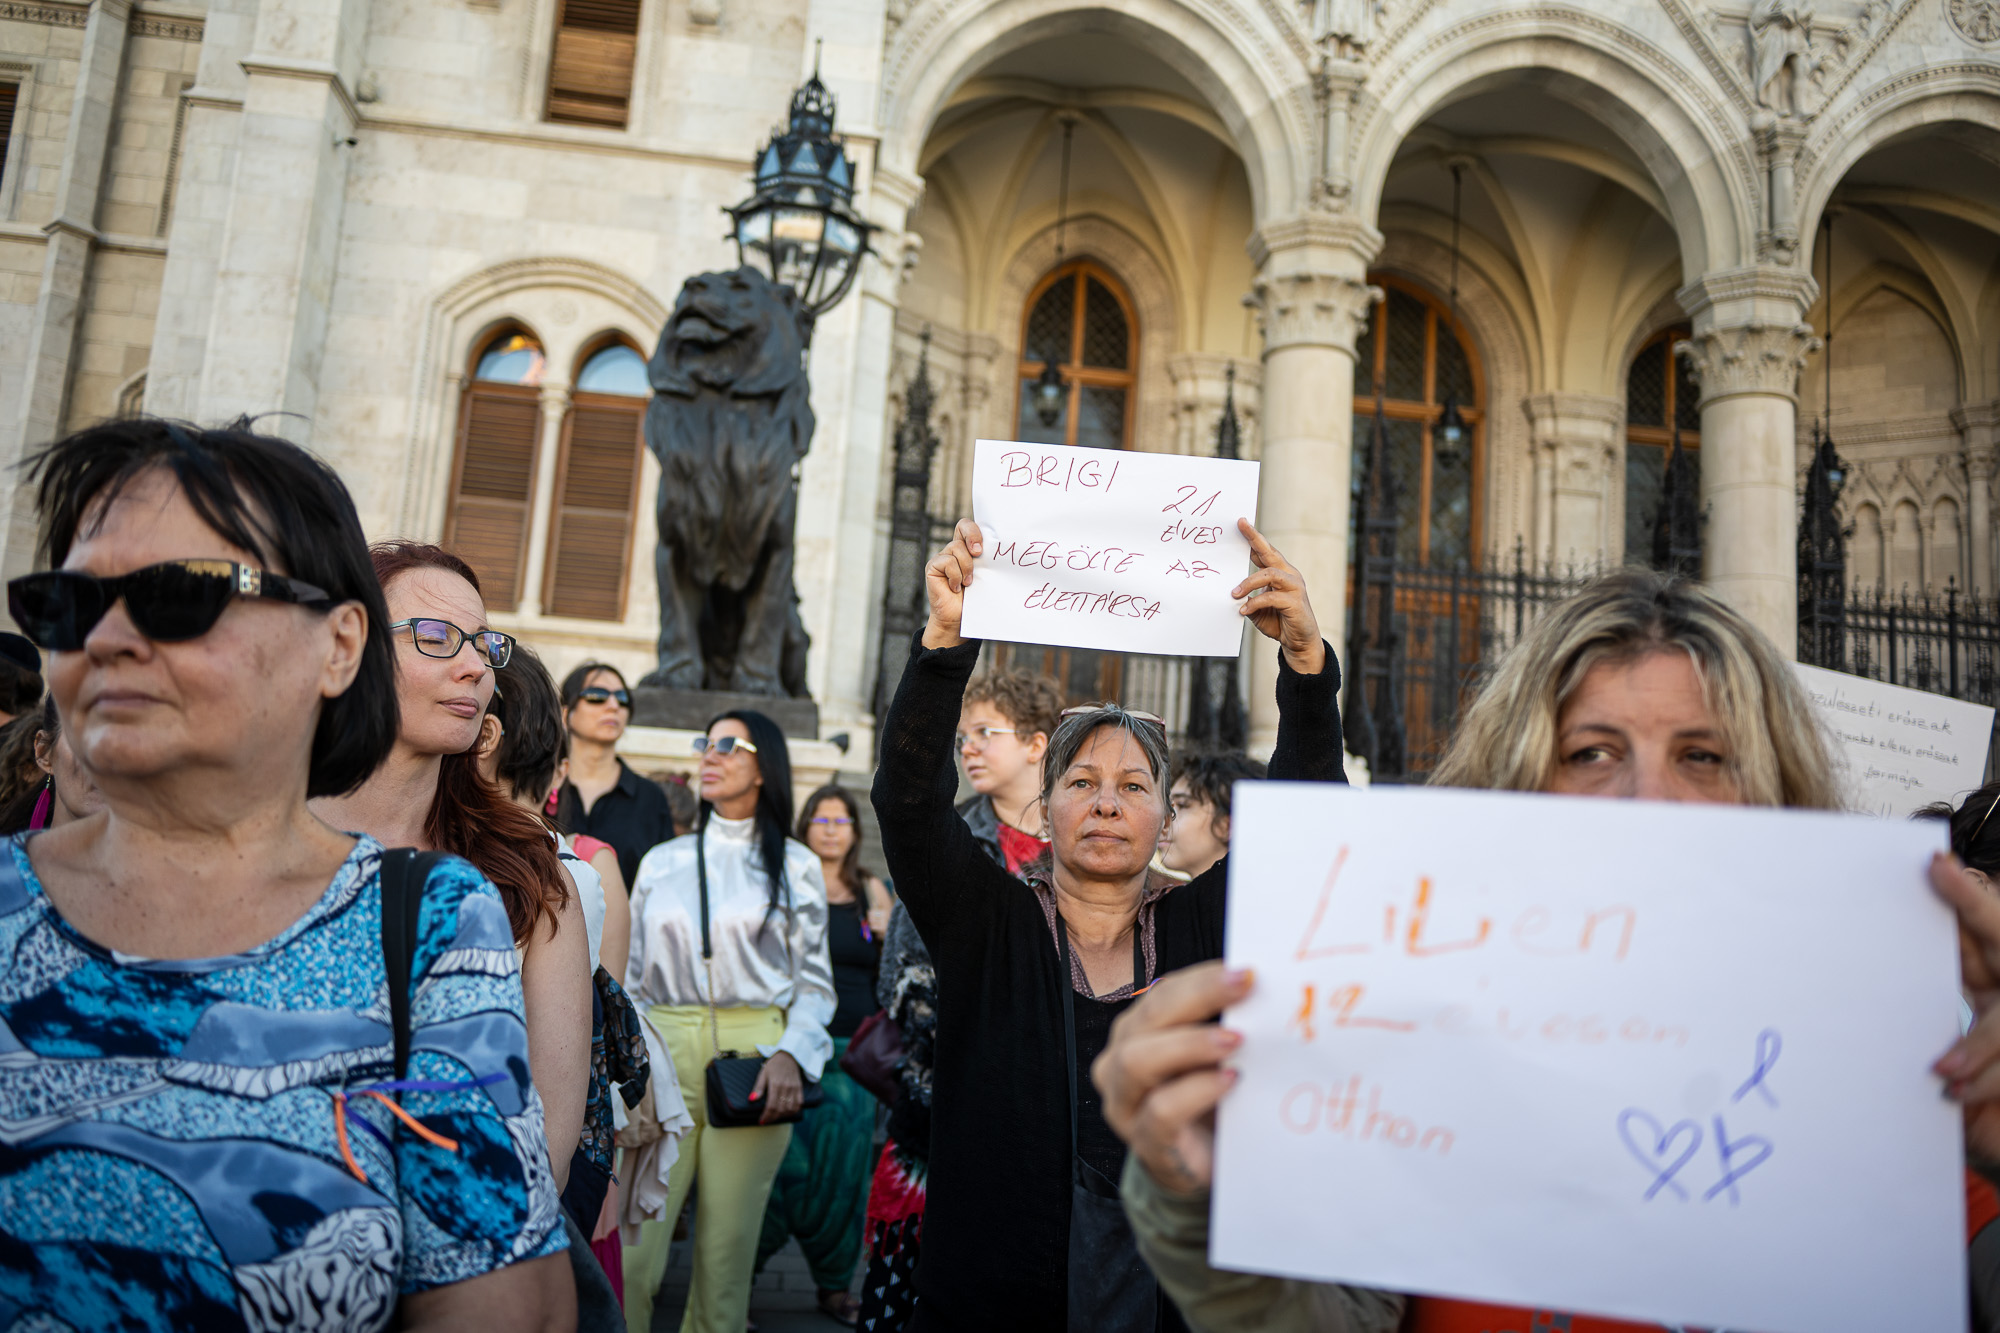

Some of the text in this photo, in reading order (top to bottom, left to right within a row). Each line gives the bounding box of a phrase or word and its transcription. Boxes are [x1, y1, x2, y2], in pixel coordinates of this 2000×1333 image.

[1000, 451, 1120, 492] BRIGI
[1162, 485, 1222, 516] 21
[1160, 519, 1223, 544] ÉVES
[993, 541, 1221, 578] MEGÖLTE AZ
[1023, 582, 1161, 620] ÉLETTÁRSA
[1287, 981, 1417, 1043] 12
[1279, 1074, 1456, 1156] Otthon
